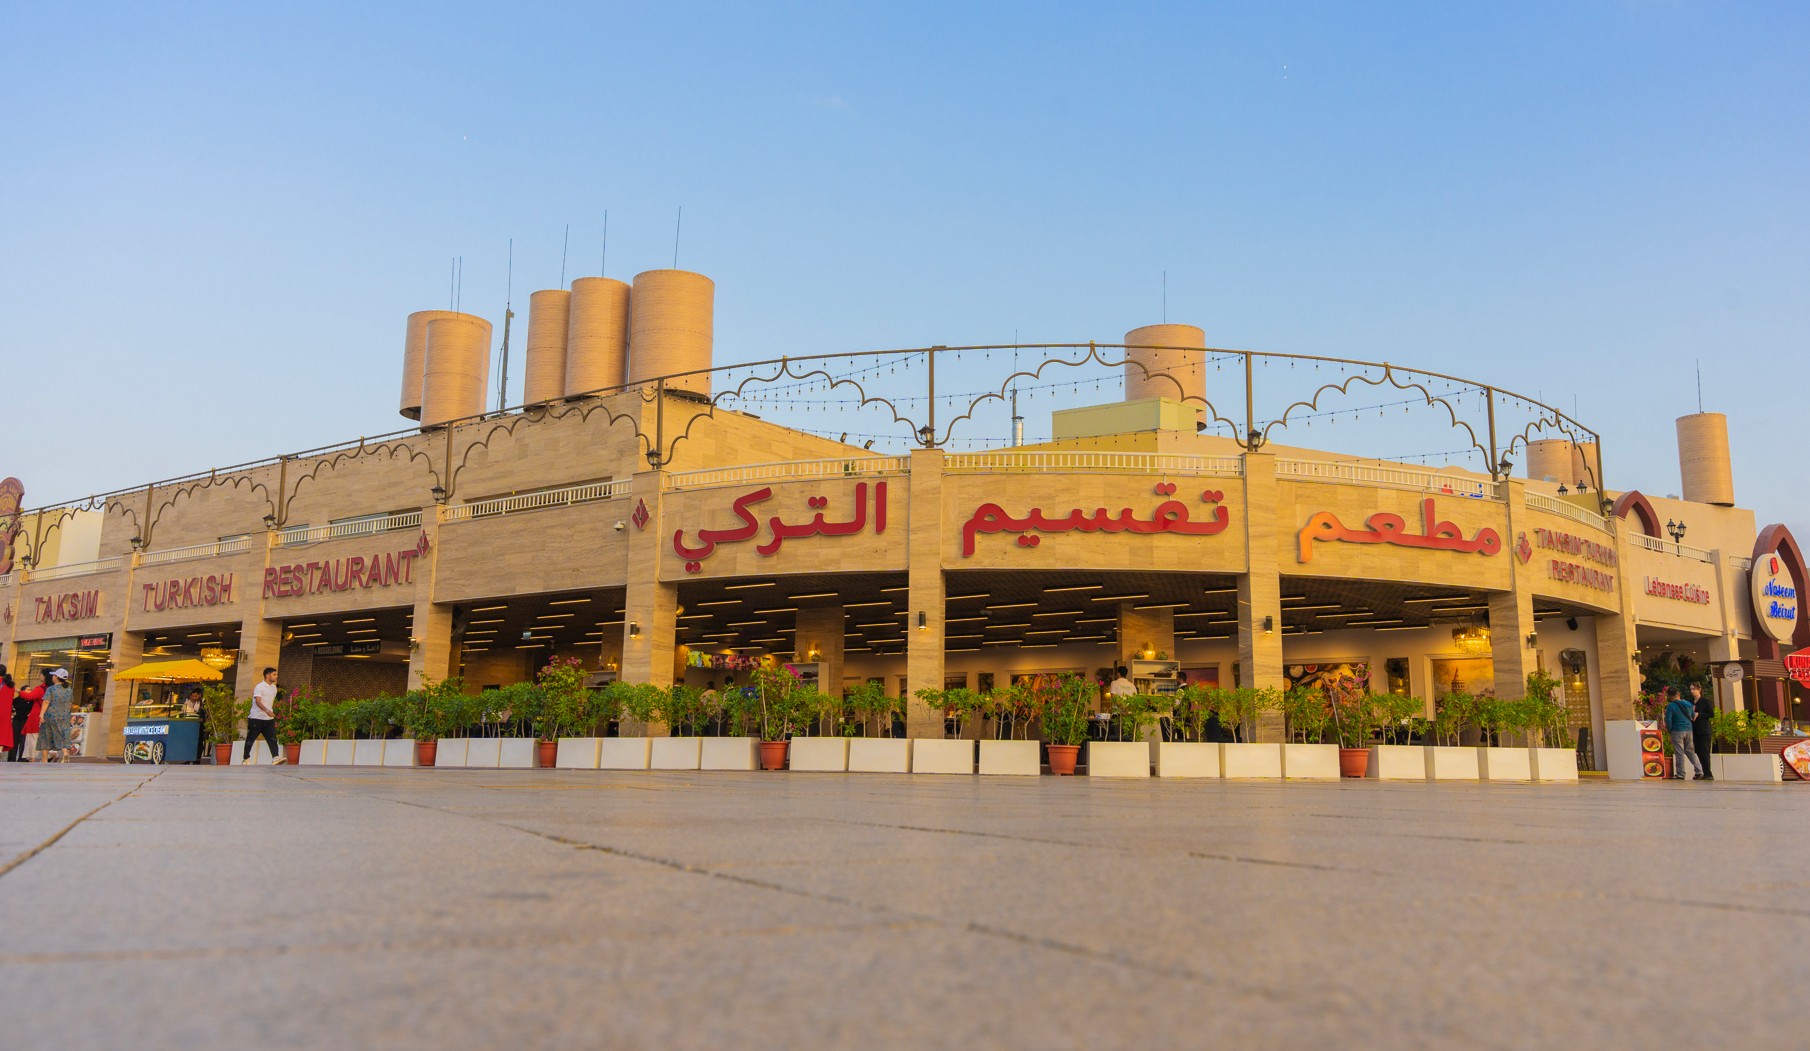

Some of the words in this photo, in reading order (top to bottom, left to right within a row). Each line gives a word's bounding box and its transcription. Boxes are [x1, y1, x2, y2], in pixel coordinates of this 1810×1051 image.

[674, 481, 888, 573] التركي
[962, 483, 1229, 558] تقسيم
[1298, 498, 1501, 563] مطعم
[1534, 528, 1581, 555] TAKSIM
[35, 589, 100, 623] TAKSIM
[143, 573, 233, 612] TURKISH
[262, 550, 418, 599] RESTAURANT
[1548, 560, 1613, 592] RESTAURANT
[1644, 576, 1683, 600] Lebanese
[1683, 583, 1710, 605] Cuisine
[1763, 578, 1796, 599] Naseem
[1768, 601, 1796, 620] Beirut
